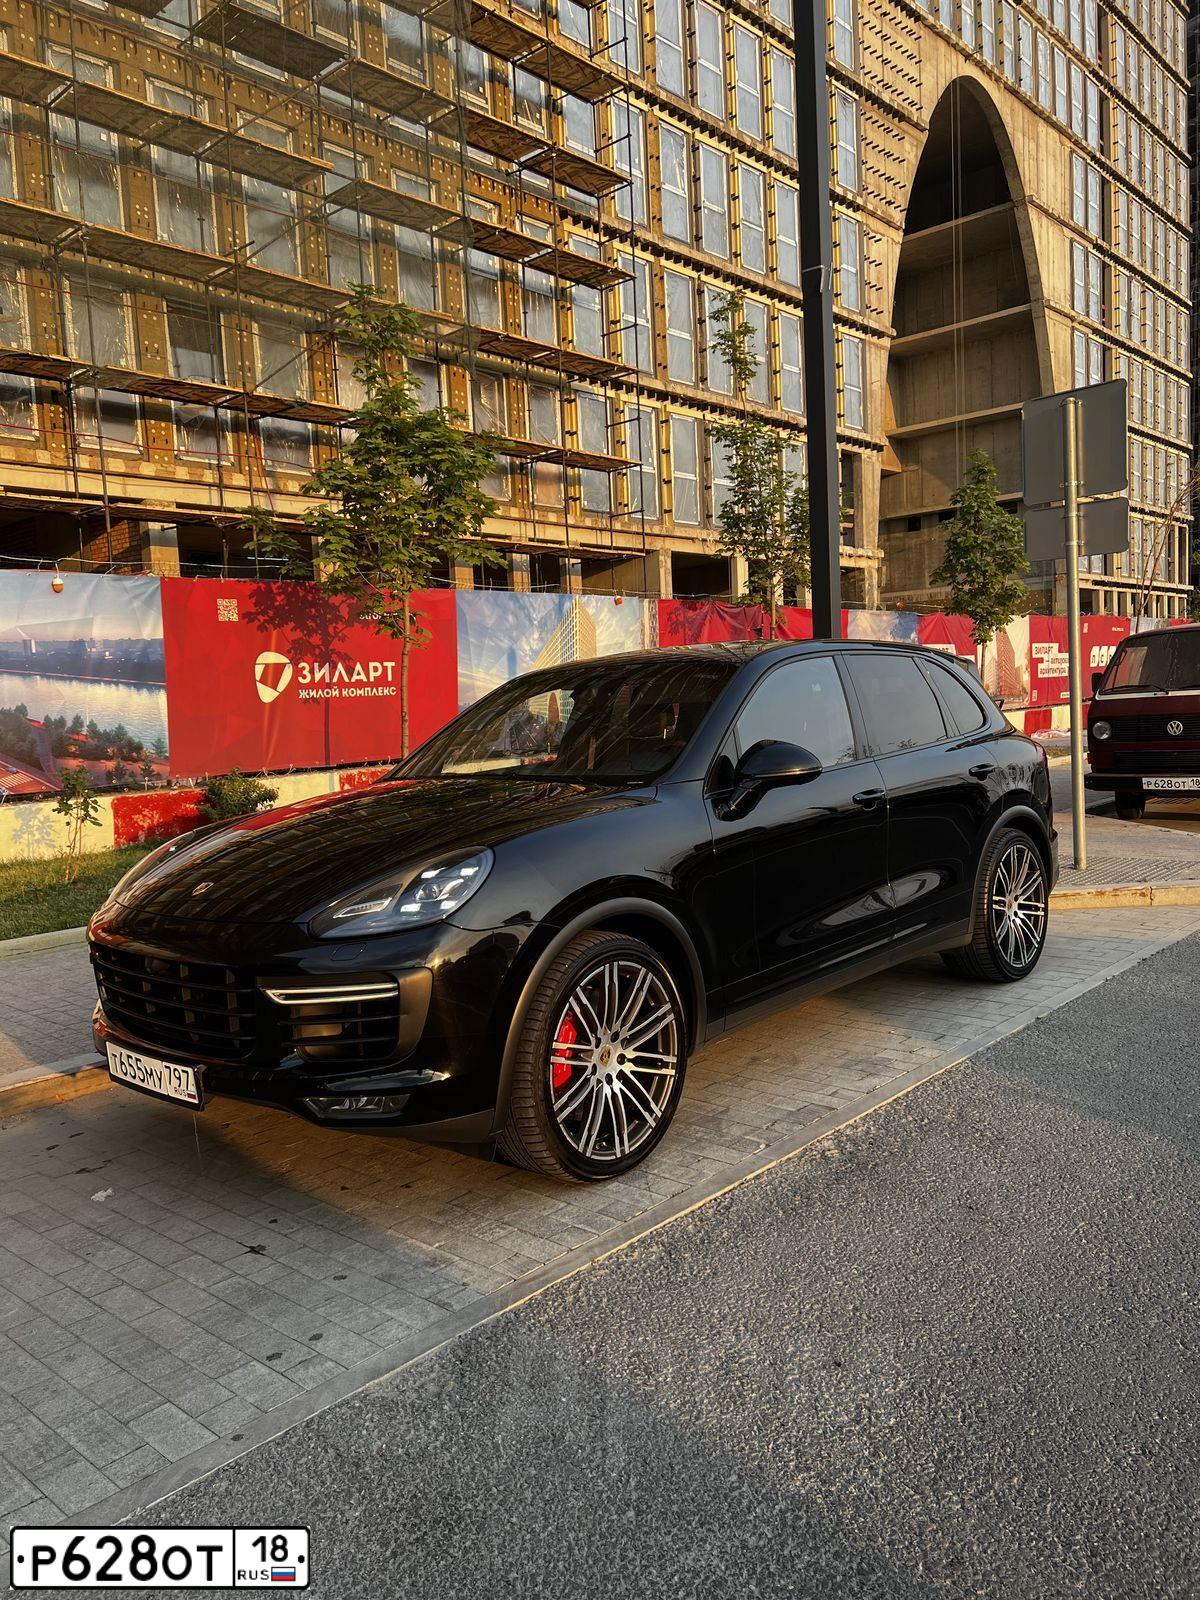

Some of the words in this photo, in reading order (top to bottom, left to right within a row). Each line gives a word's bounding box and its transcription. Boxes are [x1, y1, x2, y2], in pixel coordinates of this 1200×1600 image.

[297, 661, 396, 684] ЗИЛАРТ
[298, 686, 340, 699] ЖИЛОЙ
[341, 686, 397, 698] КОМПЛЕКС
[111, 1051, 163, 1090] Т655МУ
[164, 1065, 190, 1091] 797
[174, 1086, 188, 1097] RUS
